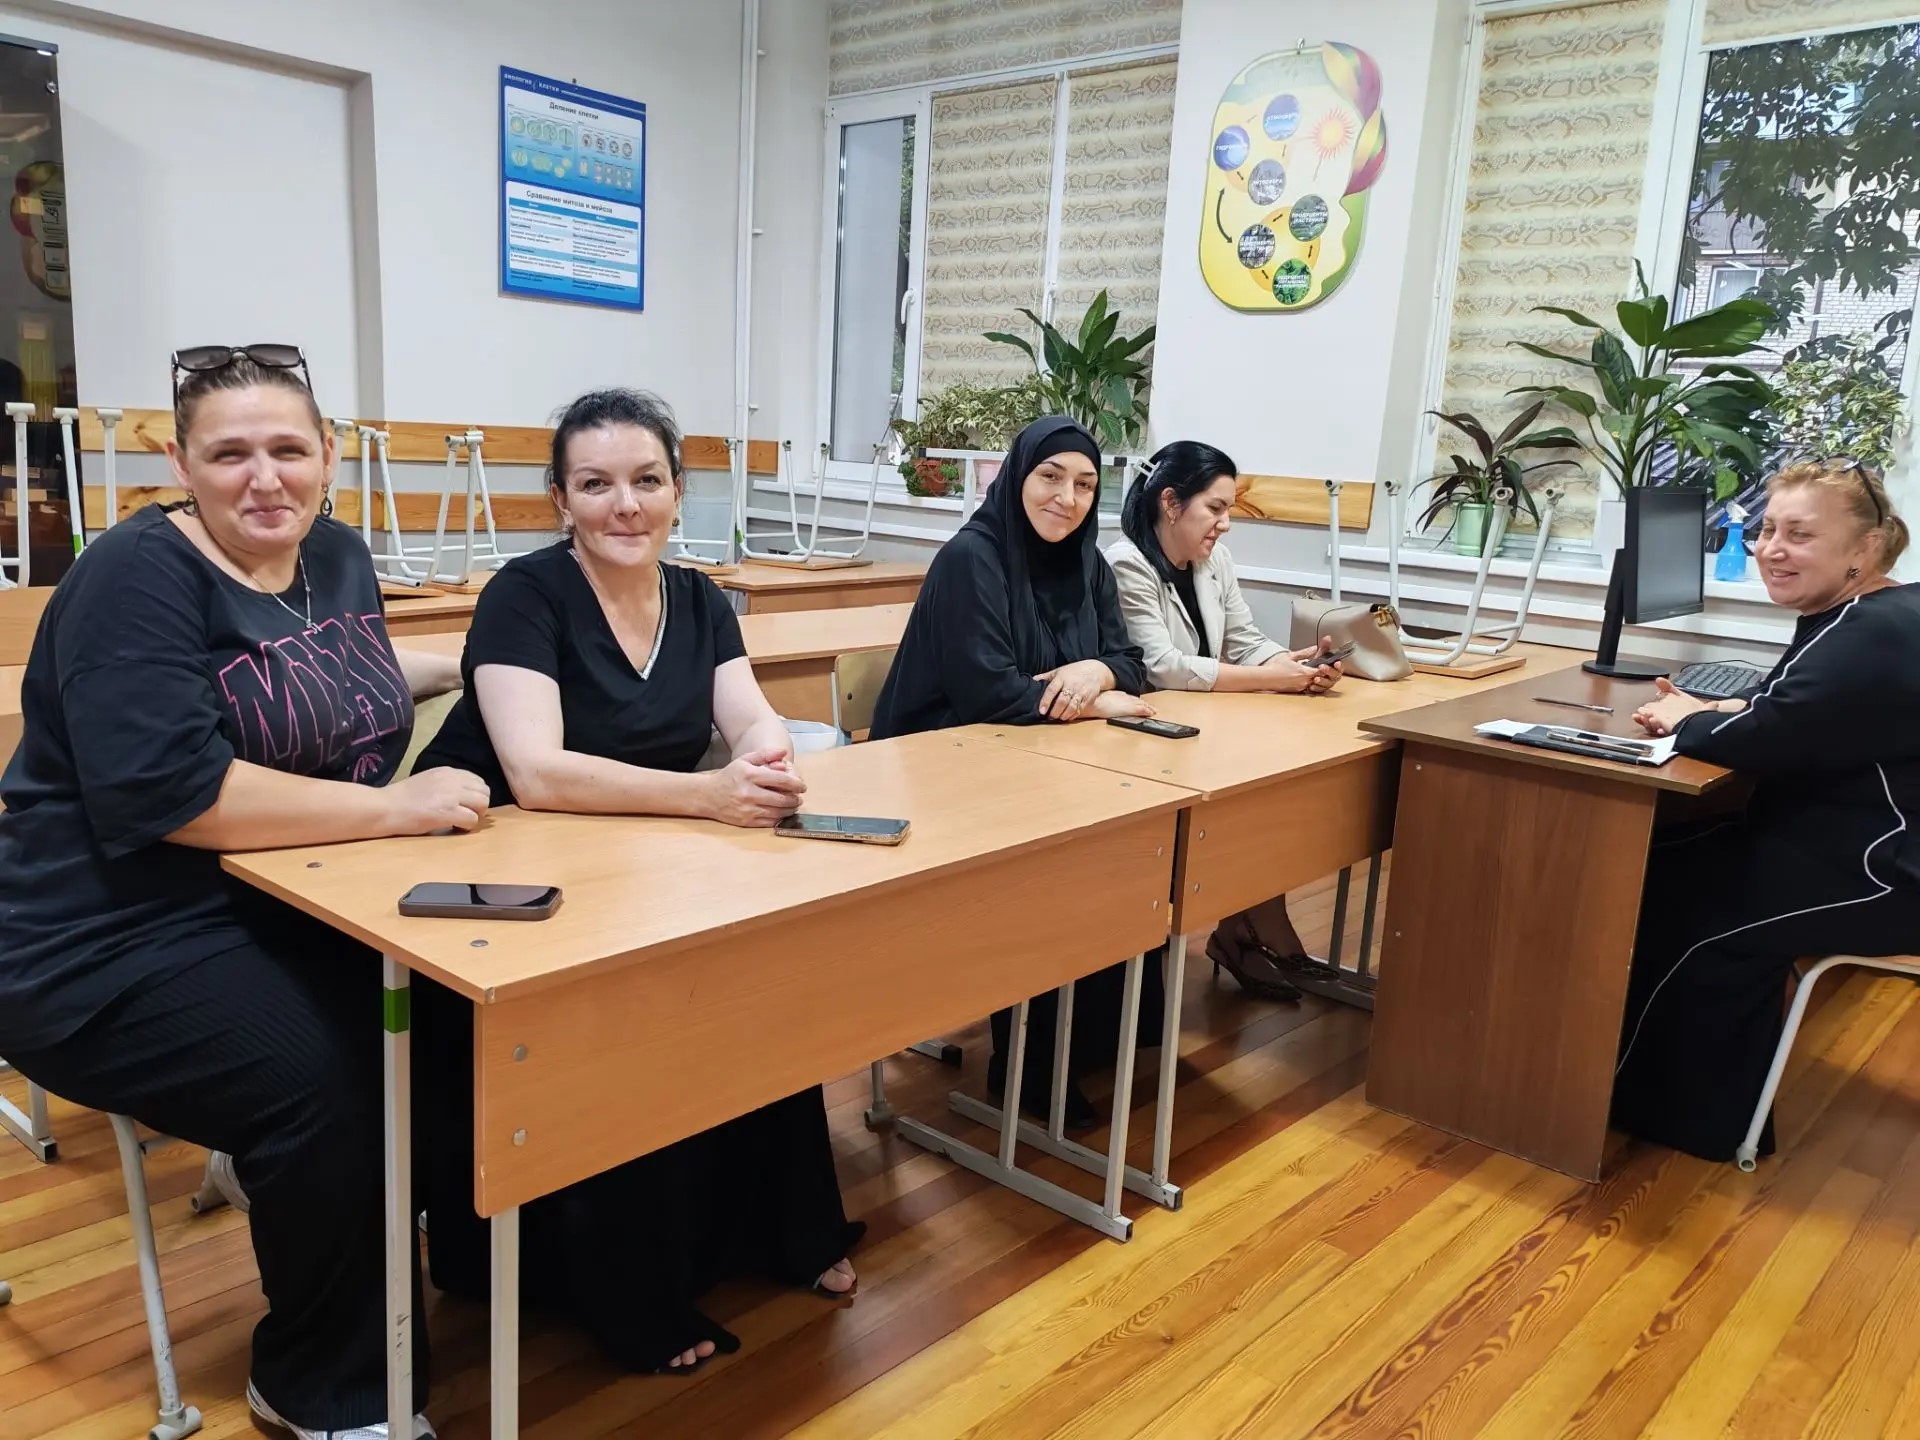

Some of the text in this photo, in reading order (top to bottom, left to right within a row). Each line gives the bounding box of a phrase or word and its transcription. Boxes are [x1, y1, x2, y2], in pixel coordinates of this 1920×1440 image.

[549, 101, 576, 114] Деление
[526, 190, 561, 203] Сравнение
[562, 198, 585, 208] митоза
[591, 203, 613, 214] мейоза
